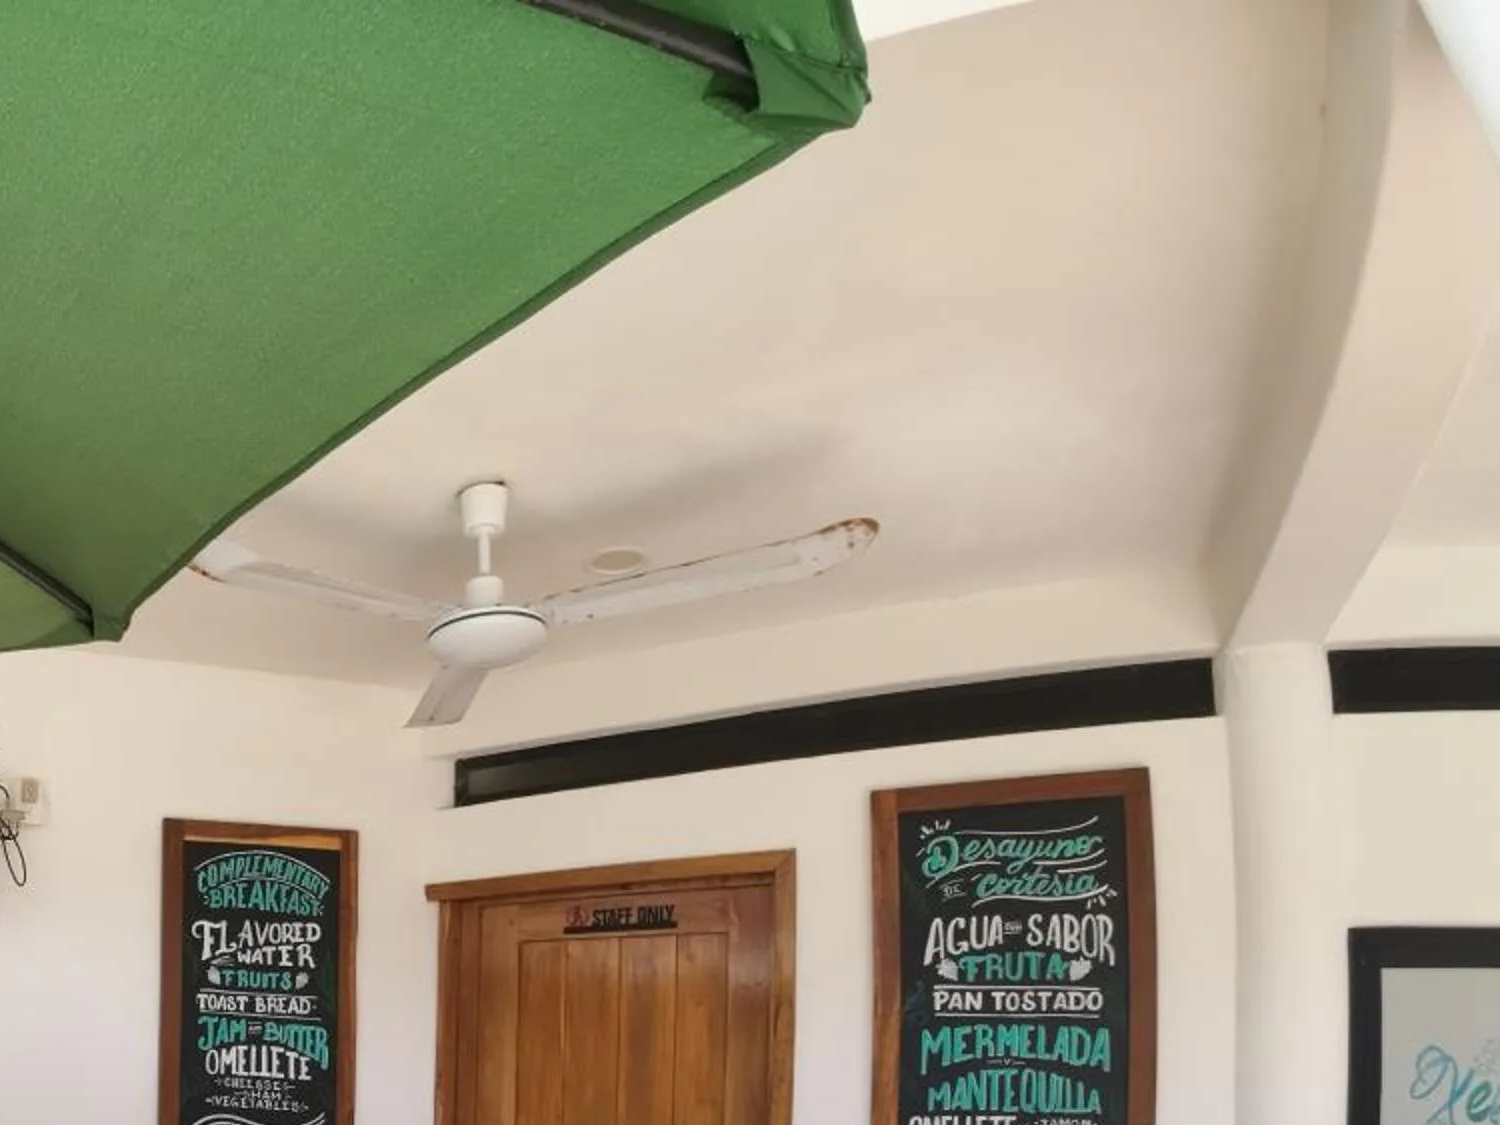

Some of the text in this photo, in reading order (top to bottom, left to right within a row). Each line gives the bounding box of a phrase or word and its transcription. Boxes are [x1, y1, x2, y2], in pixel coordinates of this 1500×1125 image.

[921, 835, 1103, 880] Desayuno
[209, 879, 321, 917] BREAKFAST
[593, 904, 675, 926] STAFF ONLY
[191, 919, 322, 961] FLAVORED
[237, 944, 316, 969] WATER
[924, 914, 1004, 966] AGUA
[1026, 913, 1115, 966] SABOR
[220, 969, 293, 990] FRUITS
[960, 951, 1069, 982] FRUTA
[196, 993, 311, 1014] TOAST BREAD
[933, 991, 1104, 1012] PAN TOSTADO
[198, 1015, 246, 1050] JAM
[263, 1022, 329, 1069] BUTTER
[920, 1023, 1111, 1075] MERMELADA
[205, 1045, 313, 1081] OMELLETE
[927, 1068, 1103, 1115] MANTEQUILLA
